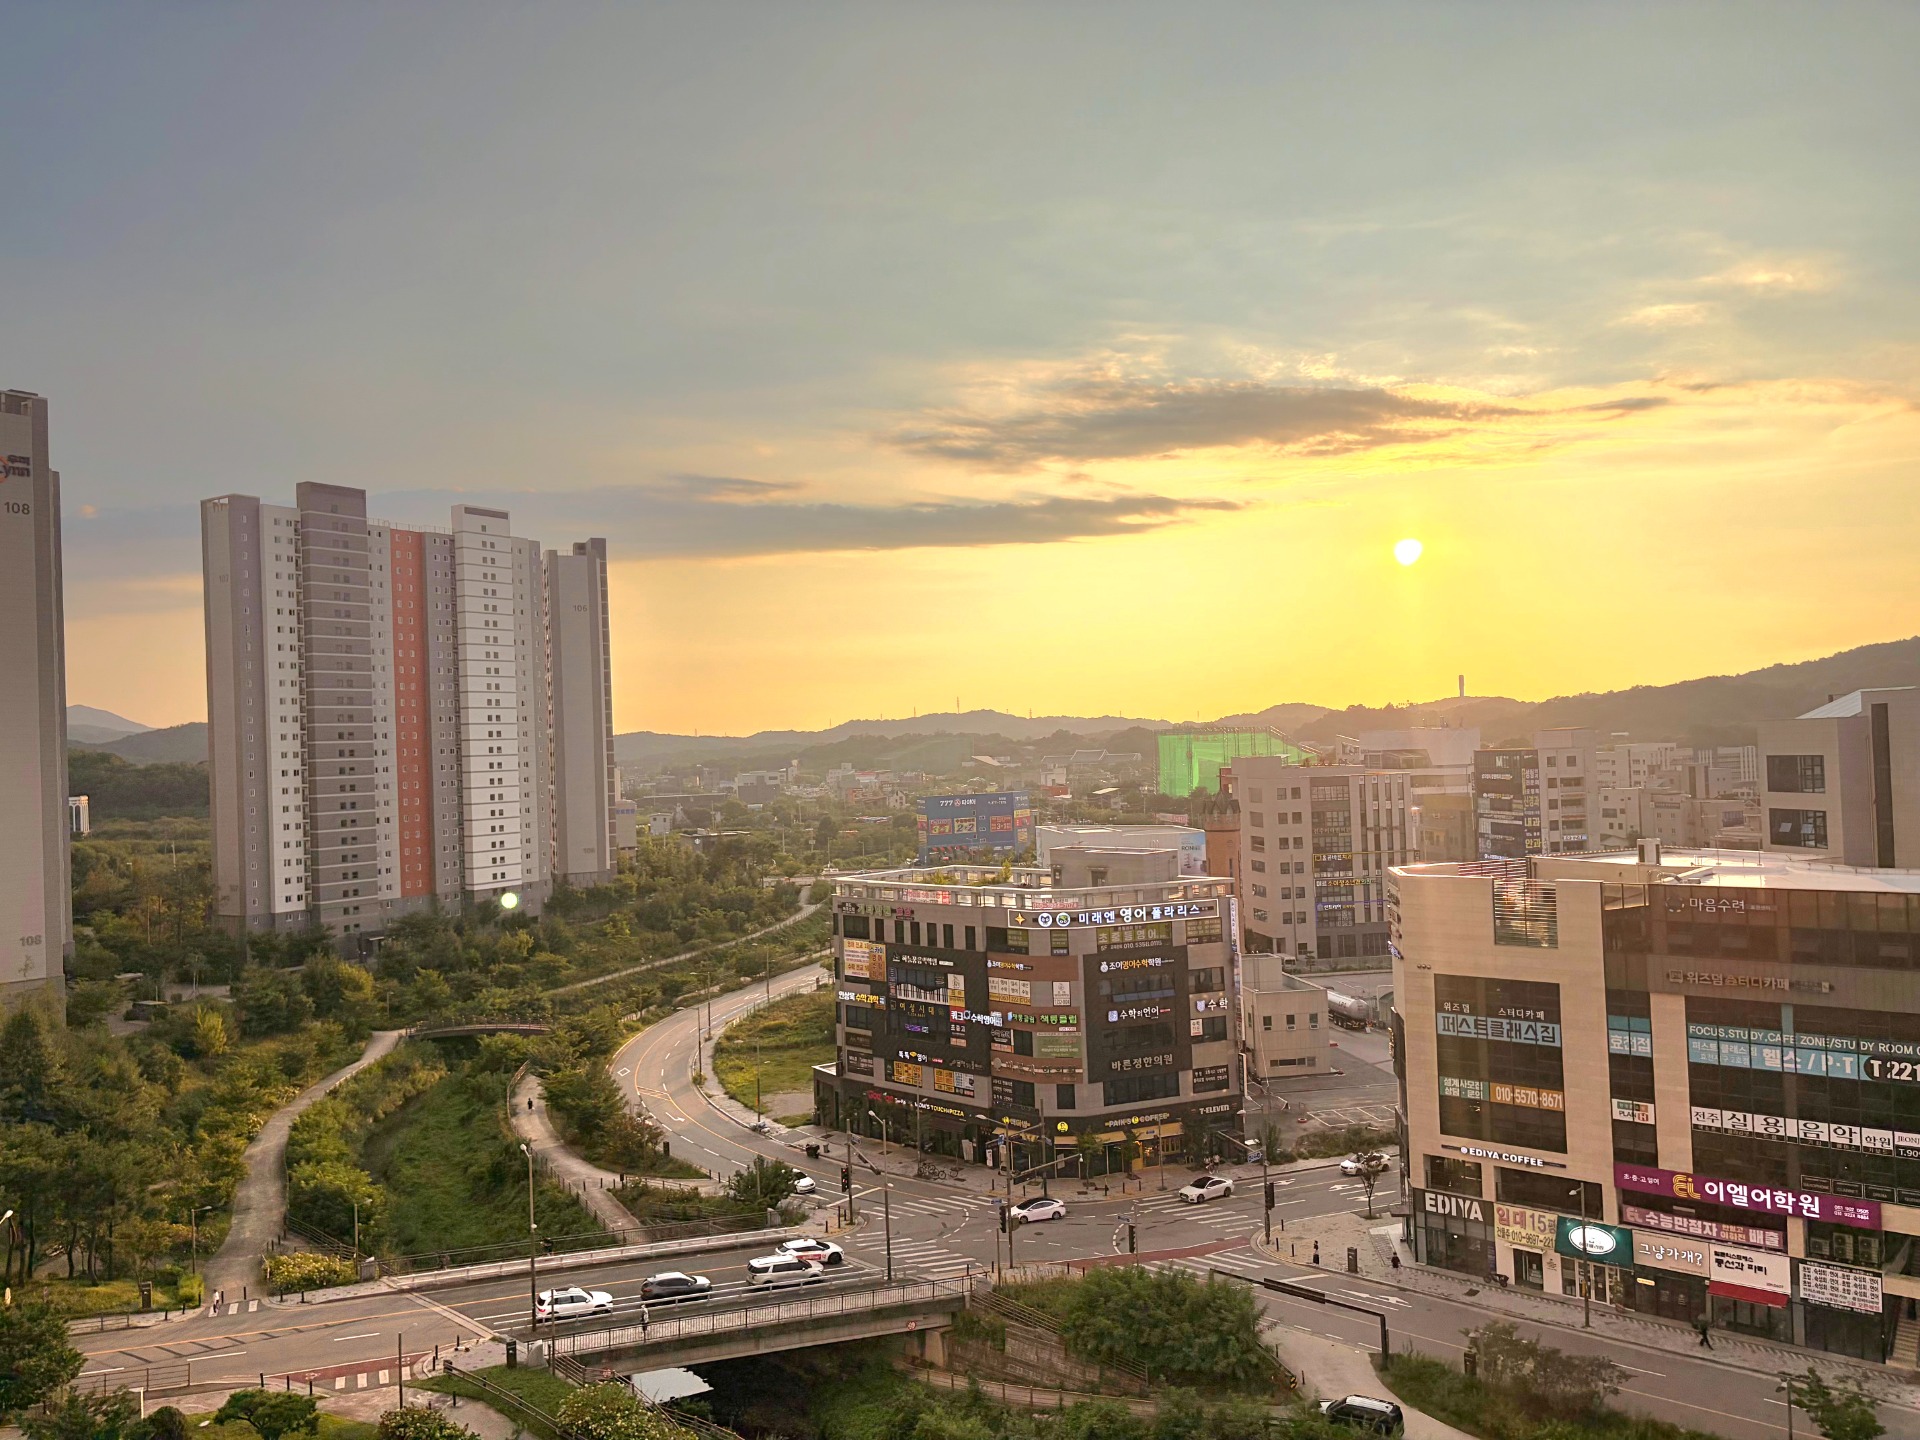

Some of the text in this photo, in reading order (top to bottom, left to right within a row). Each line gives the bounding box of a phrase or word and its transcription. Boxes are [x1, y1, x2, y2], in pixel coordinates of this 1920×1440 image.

[4, 501, 30, 515] 108
[573, 604, 588, 612] 106
[1525, 817, 1540, 826] 내과
[1525, 839, 1540, 848] 안과
[1689, 898, 1745, 913] 마음수련
[1079, 904, 1200, 925] 미래엔 영어 폴라리스
[1686, 971, 1723, 985] 위즈덤
[1208, 998, 1228, 1011] 수학
[1498, 1007, 1545, 1020] 스터디카페
[1441, 1015, 1556, 1043] 퍼스트클래스짐
[1610, 1034, 1651, 1053] 효천점
[1878, 1043, 1913, 1055] ROOM
[917, 1053, 928, 1063] 영어
[1112, 1053, 1173, 1071] 바른정한의원
[1763, 1048, 1801, 1068] 헬스
[1444, 1077, 1484, 1091] 설계사모집
[949, 1109, 964, 1117] PIZZA
[1140, 1113, 1168, 1123] COFFEE
[1619, 1110, 1637, 1118] PLAN
[1693, 1111, 1891, 1149] 전주 실용음악 학원
[1469, 1147, 1543, 1167] EDIYA COFFEE
[1424, 1192, 1484, 1222] EDIYA
[1704, 1181, 1820, 1219] 이엘어학원
[1496, 1205, 1527, 1230] 임대
[1645, 1211, 1718, 1237] 수능만점자
[1748, 1228, 1779, 1247] 배출
